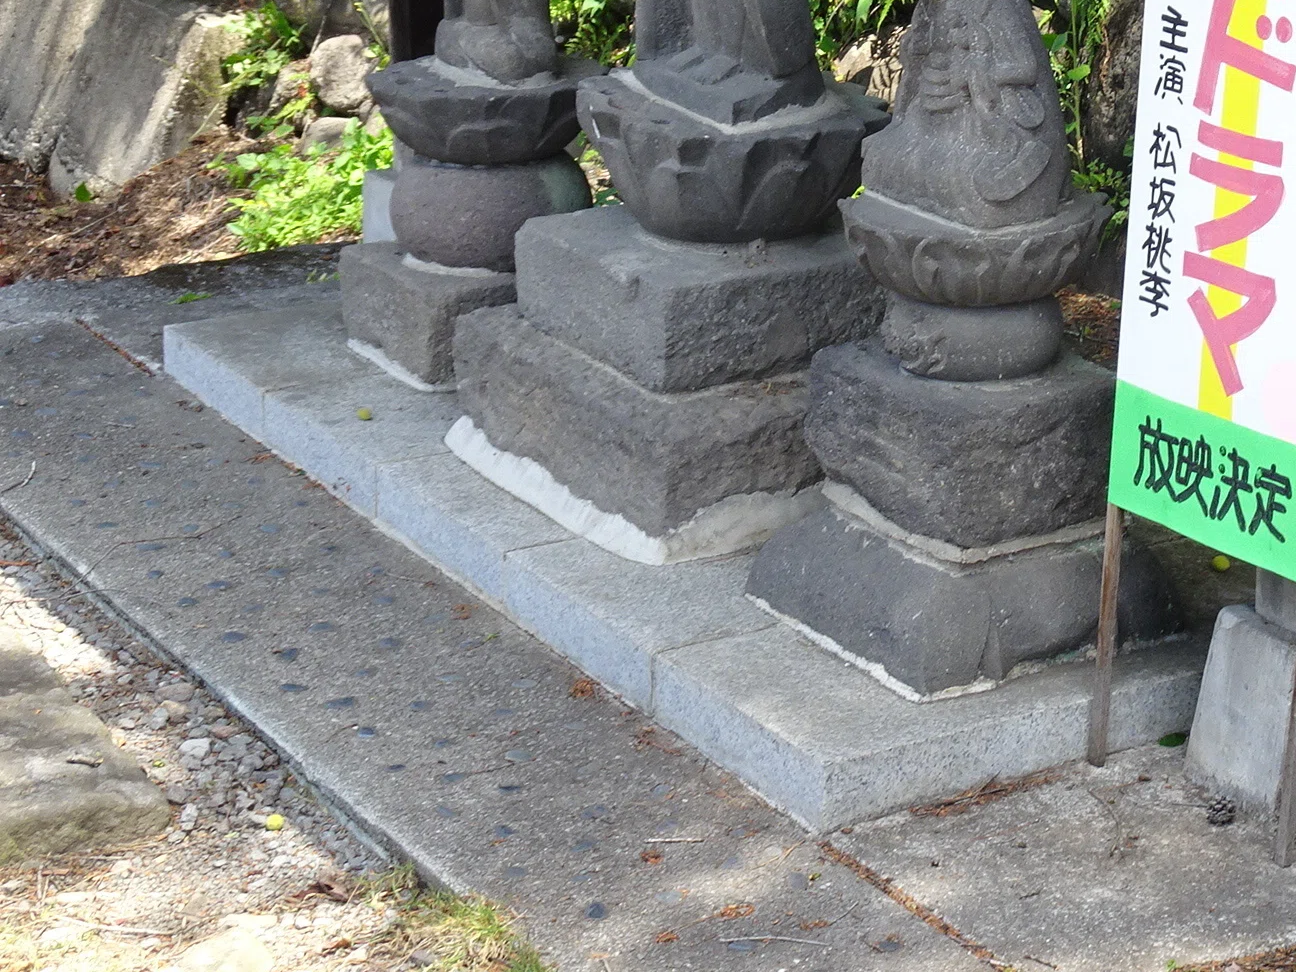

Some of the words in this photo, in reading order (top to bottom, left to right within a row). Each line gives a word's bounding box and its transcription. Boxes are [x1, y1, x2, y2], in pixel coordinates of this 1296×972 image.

[1154, 5, 1188, 105] 主演
[1139, 122, 1182, 317] 松坂桃李
[1133, 415, 1293, 543] 放映決定
